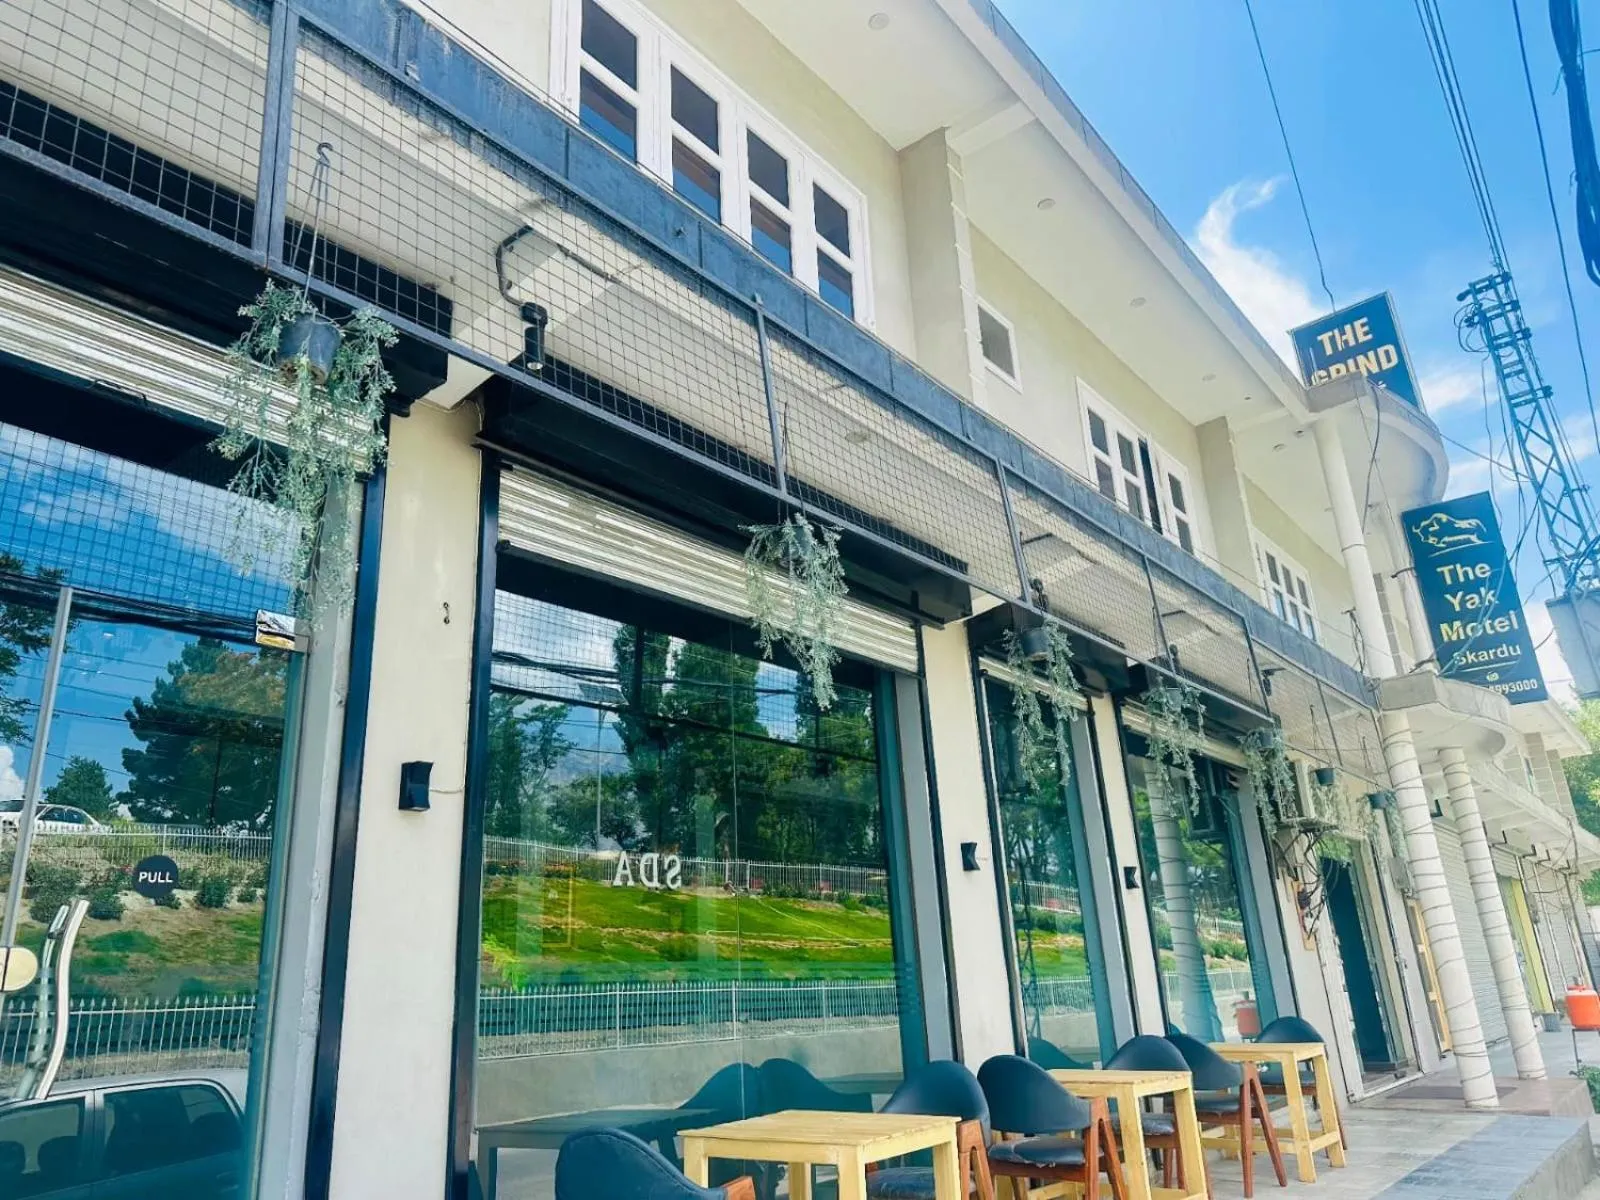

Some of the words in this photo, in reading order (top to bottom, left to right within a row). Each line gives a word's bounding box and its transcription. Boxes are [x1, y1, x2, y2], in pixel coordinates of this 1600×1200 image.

[1317, 317, 1373, 356] THE
[1436, 562, 1492, 586] The
[1444, 586, 1500, 612] Yak
[1439, 610, 1521, 643] Motel
[1453, 643, 1521, 666] Skardu
[138, 871, 174, 884] PULL
